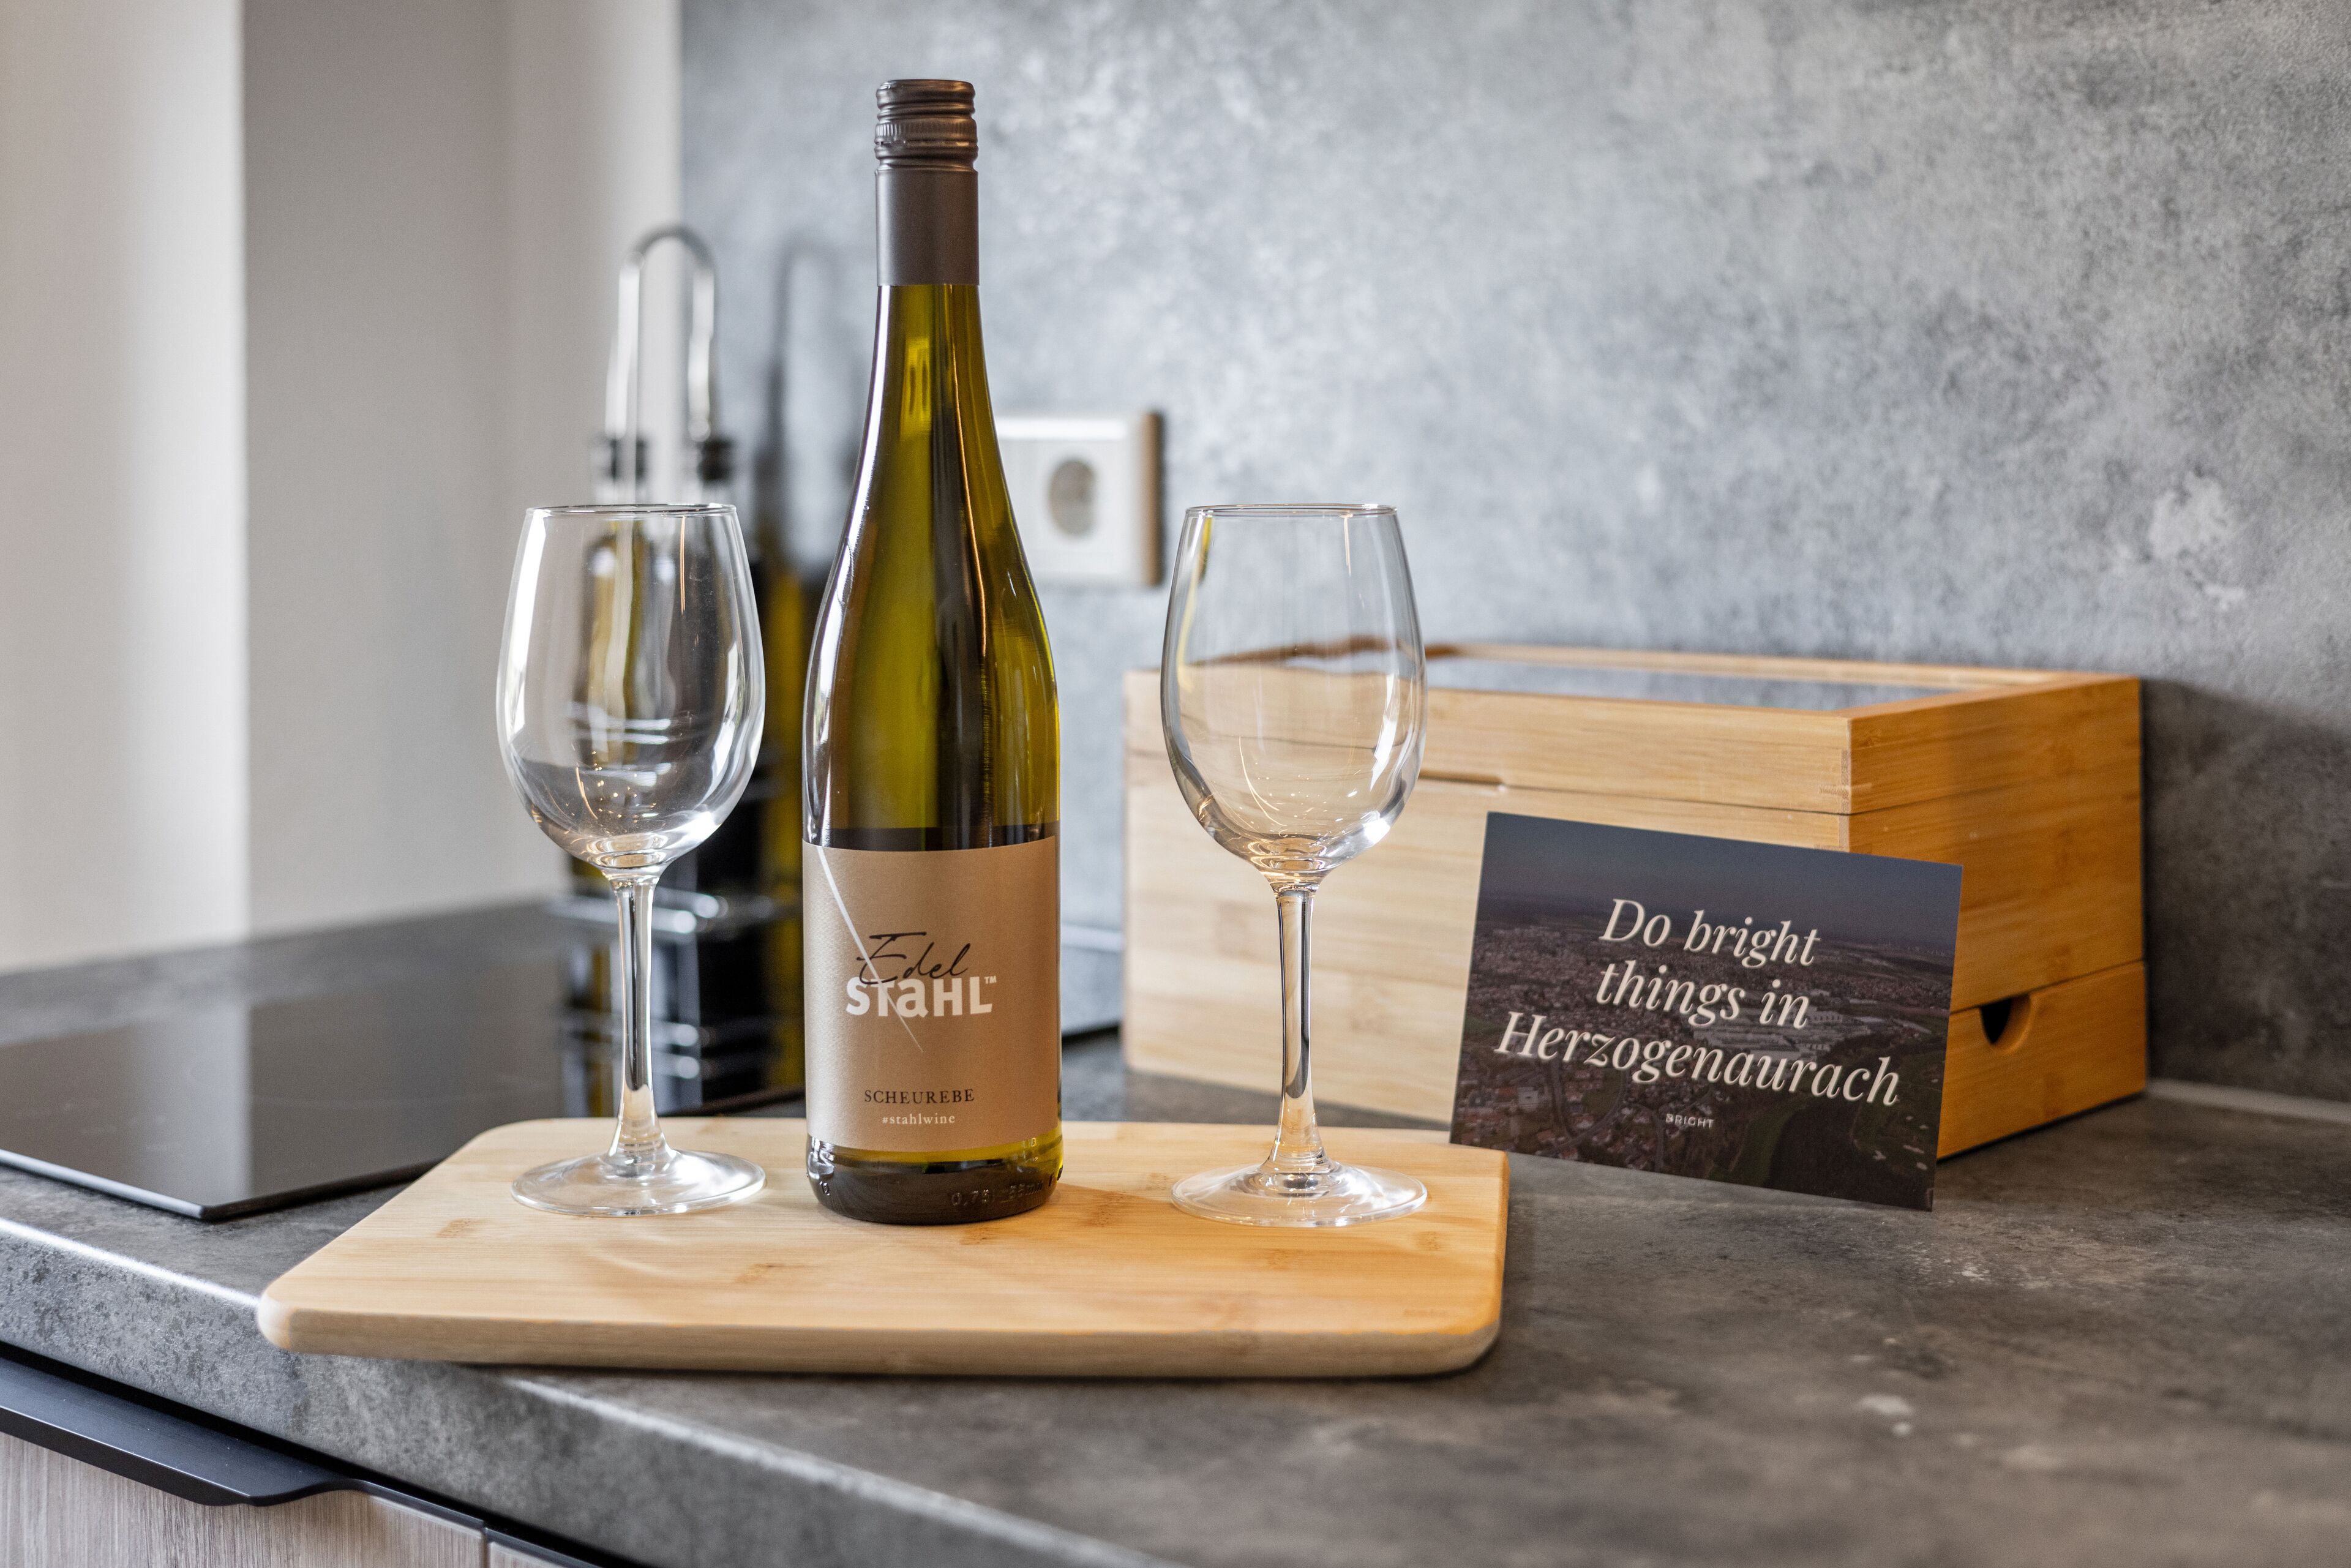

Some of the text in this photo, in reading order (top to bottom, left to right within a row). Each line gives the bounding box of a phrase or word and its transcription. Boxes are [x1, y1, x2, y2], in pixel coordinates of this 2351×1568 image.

[857, 932, 970, 985] Edel
[1599, 898, 1820, 969] Do bright
[1595, 959, 1809, 1029] things in
[1494, 1011, 1900, 1106] Herzogenaurach
[864, 1089, 975, 1104] SCHEUREBE
[882, 1112, 955, 1125] #stahlwine
[1665, 1113, 1714, 1128] BRIGHT
